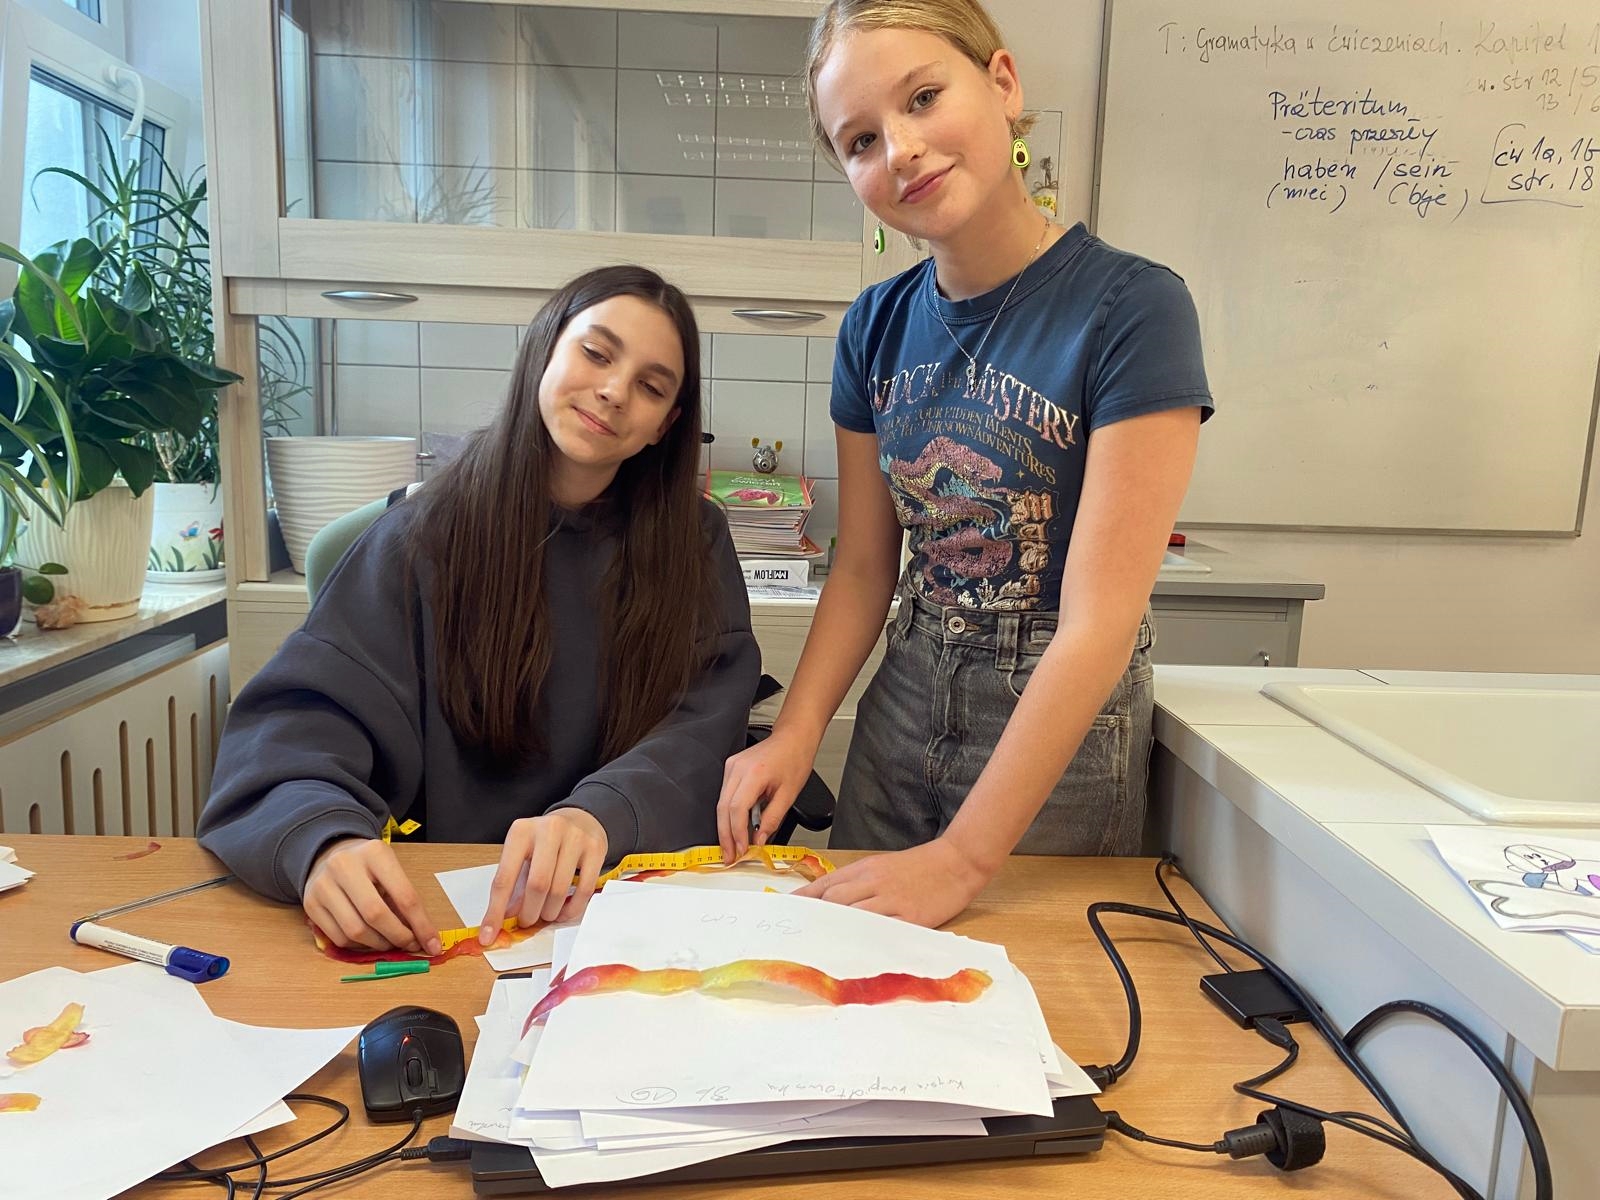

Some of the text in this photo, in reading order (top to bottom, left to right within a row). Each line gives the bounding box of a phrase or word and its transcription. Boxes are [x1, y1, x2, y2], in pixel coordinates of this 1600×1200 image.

[1195, 23, 1297, 71] Gramatyka
[1267, 86, 1409, 121] Präteritum
[1567, 165, 1595, 193] 18
[973, 425, 1057, 485] ADVENTURES
